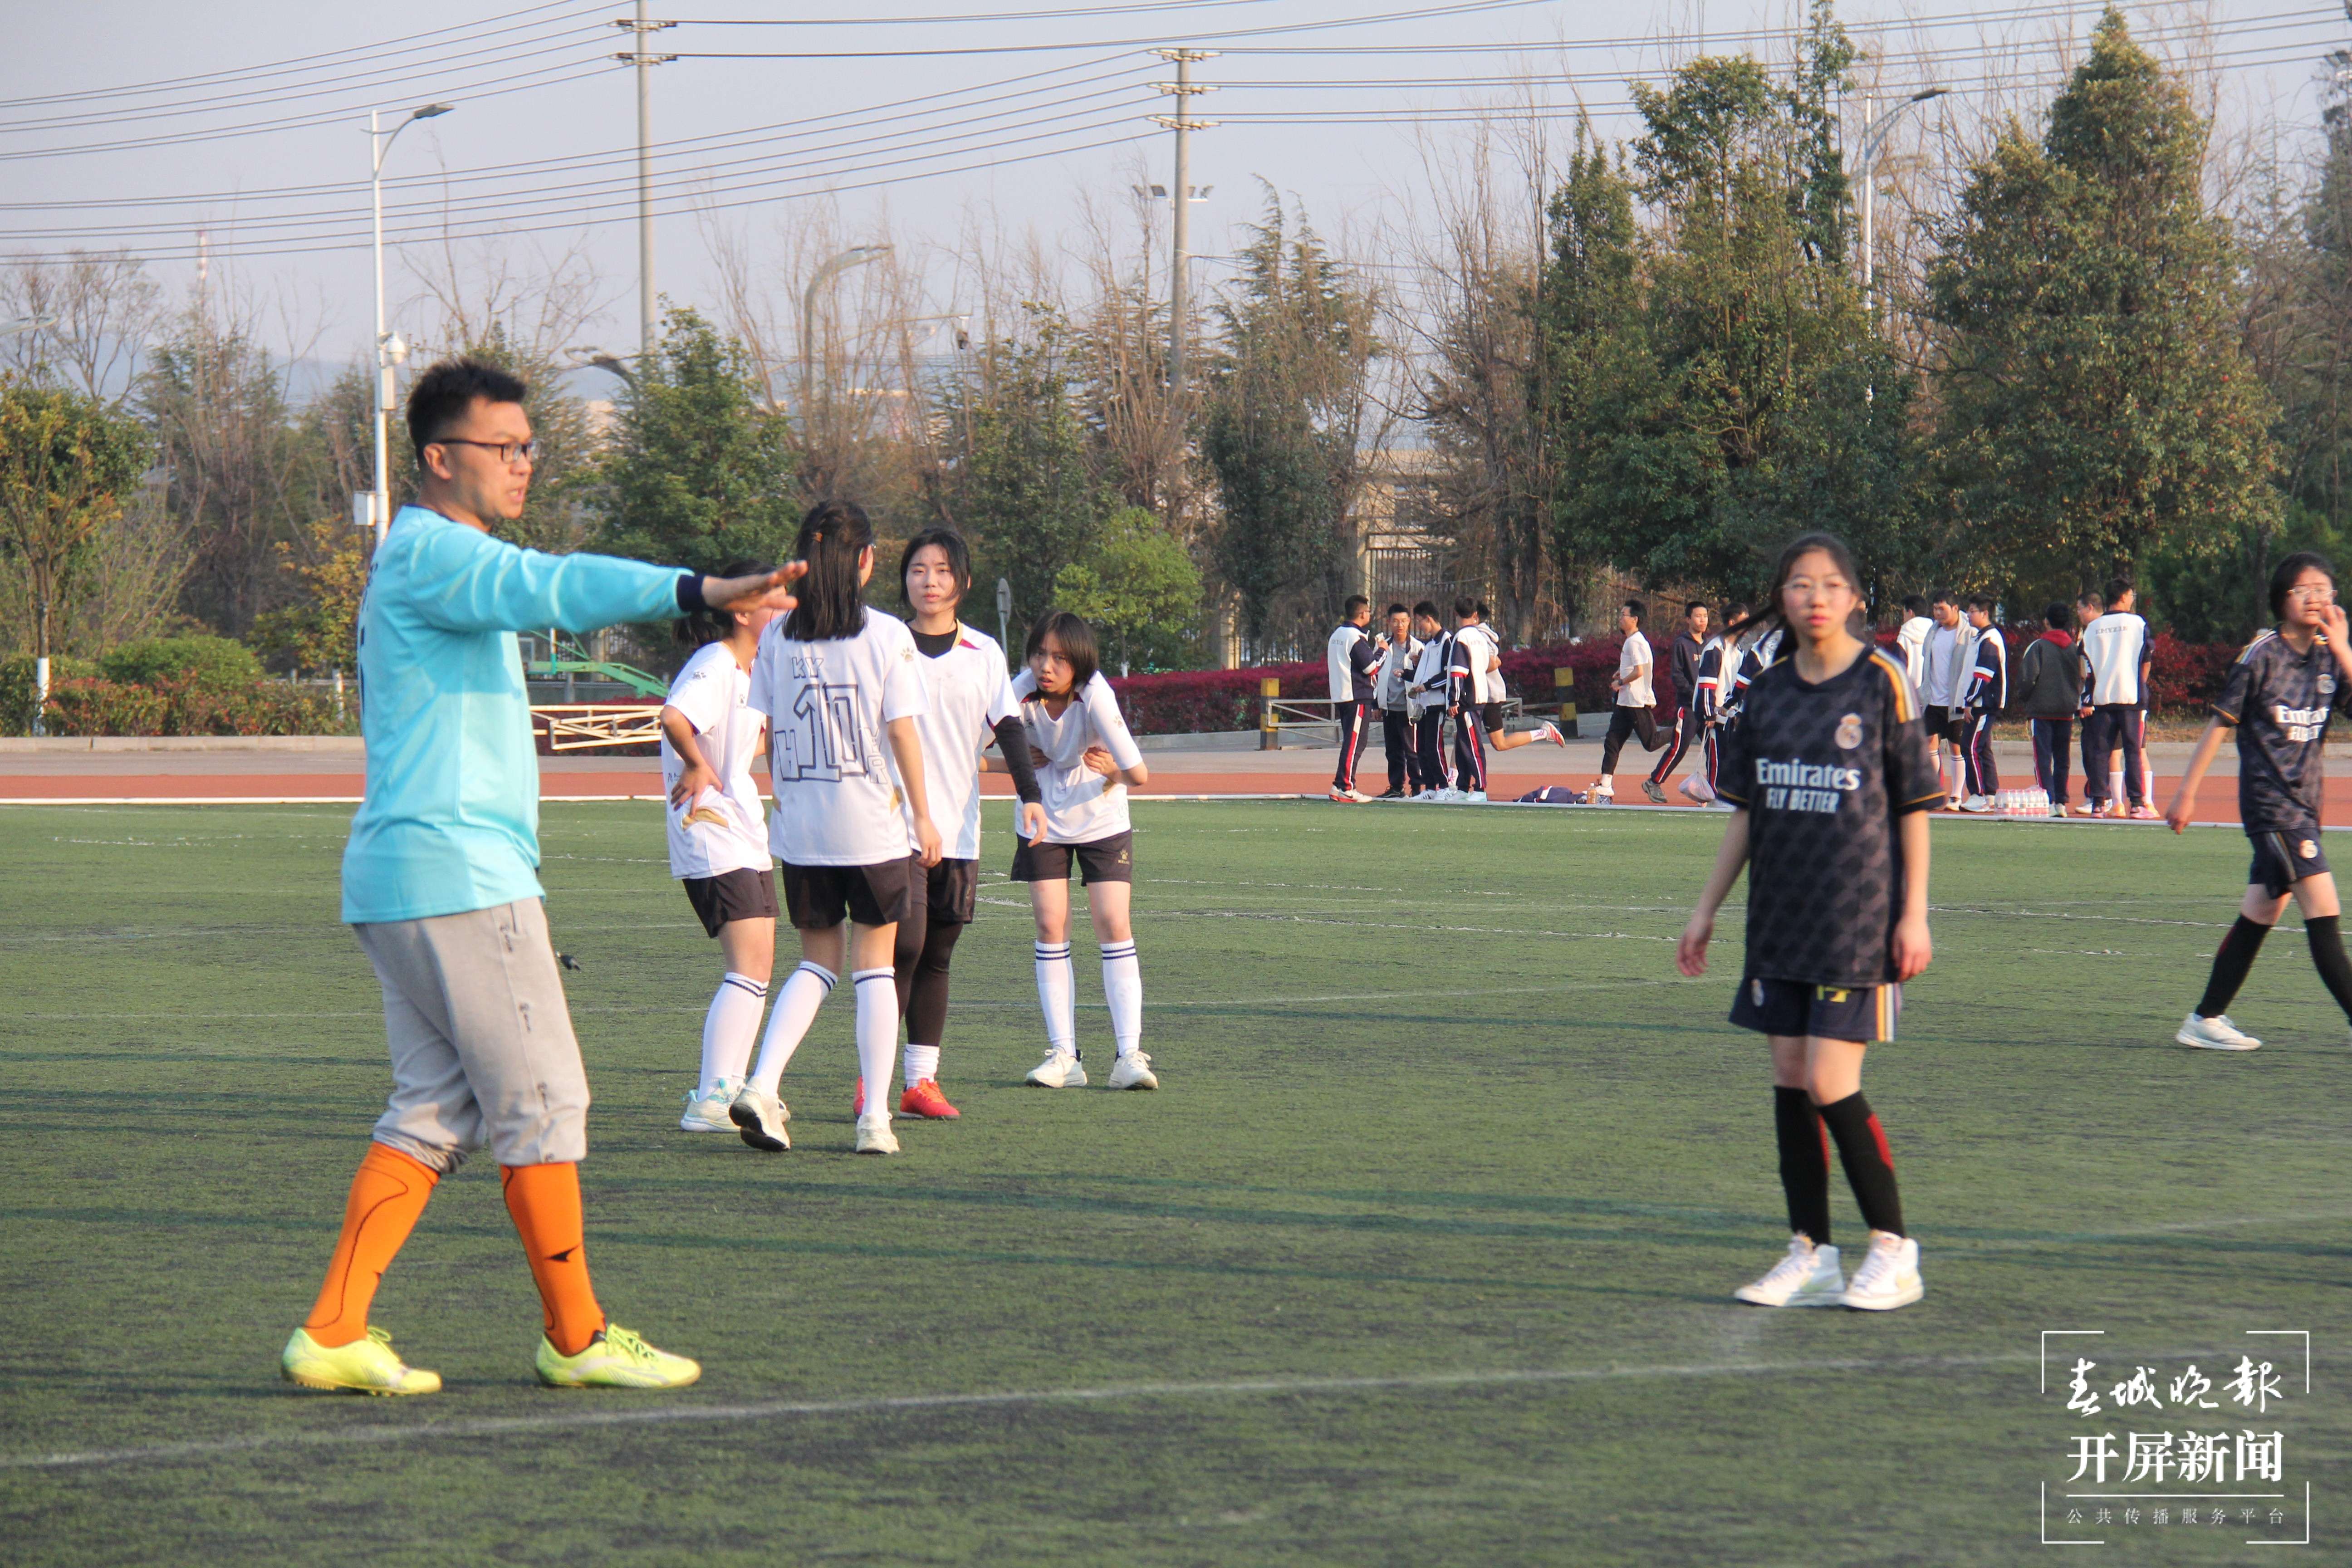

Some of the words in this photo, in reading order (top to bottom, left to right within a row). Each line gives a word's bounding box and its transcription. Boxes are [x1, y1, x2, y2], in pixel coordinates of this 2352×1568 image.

[792, 657, 824, 679] KY
[793, 682, 868, 783] 10
[1755, 757, 1861, 791] Emirates
[1766, 787, 1788, 809] FLY
[1788, 789, 1839, 813] BETTER
